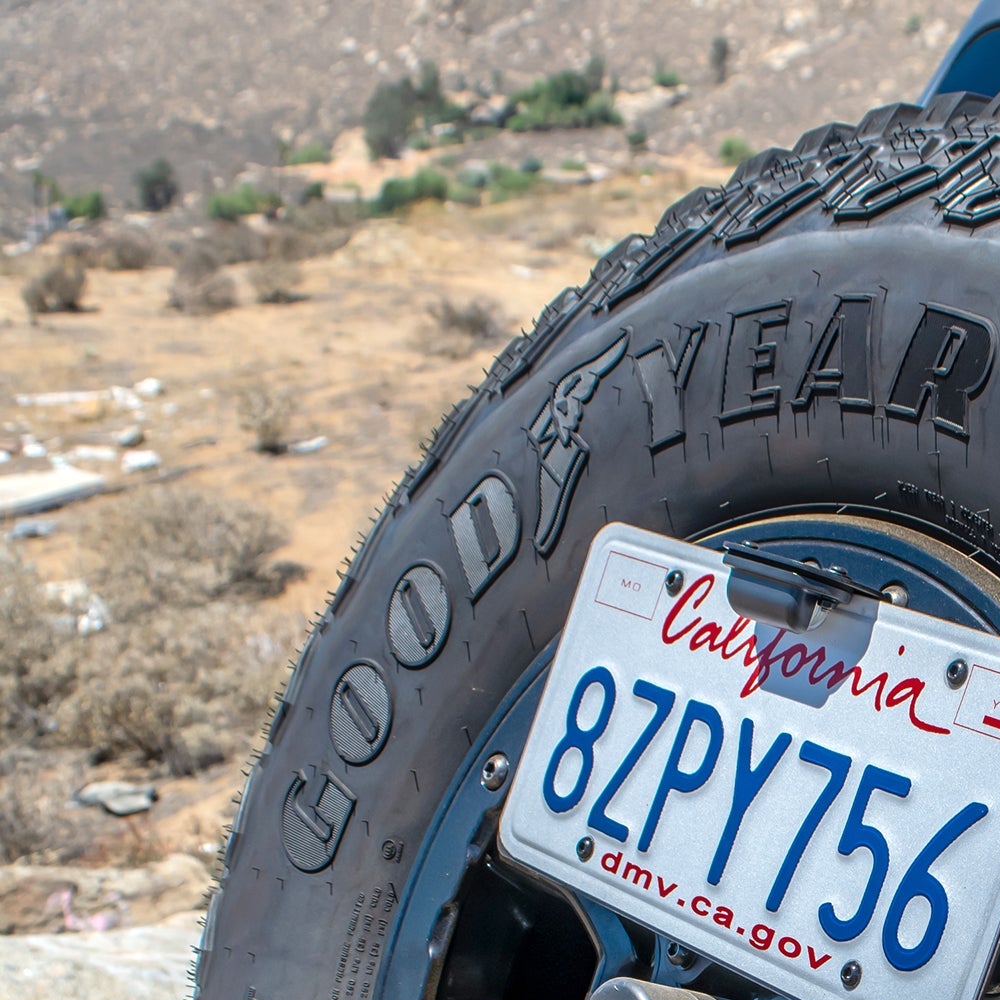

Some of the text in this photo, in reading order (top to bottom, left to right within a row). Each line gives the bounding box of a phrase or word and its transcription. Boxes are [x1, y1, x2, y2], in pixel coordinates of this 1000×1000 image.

[621, 579, 641, 592] MO
[662, 573, 950, 735] California
[542, 665, 989, 971] 8ZPY756
[601, 852, 831, 970] dmv.ca.gov
